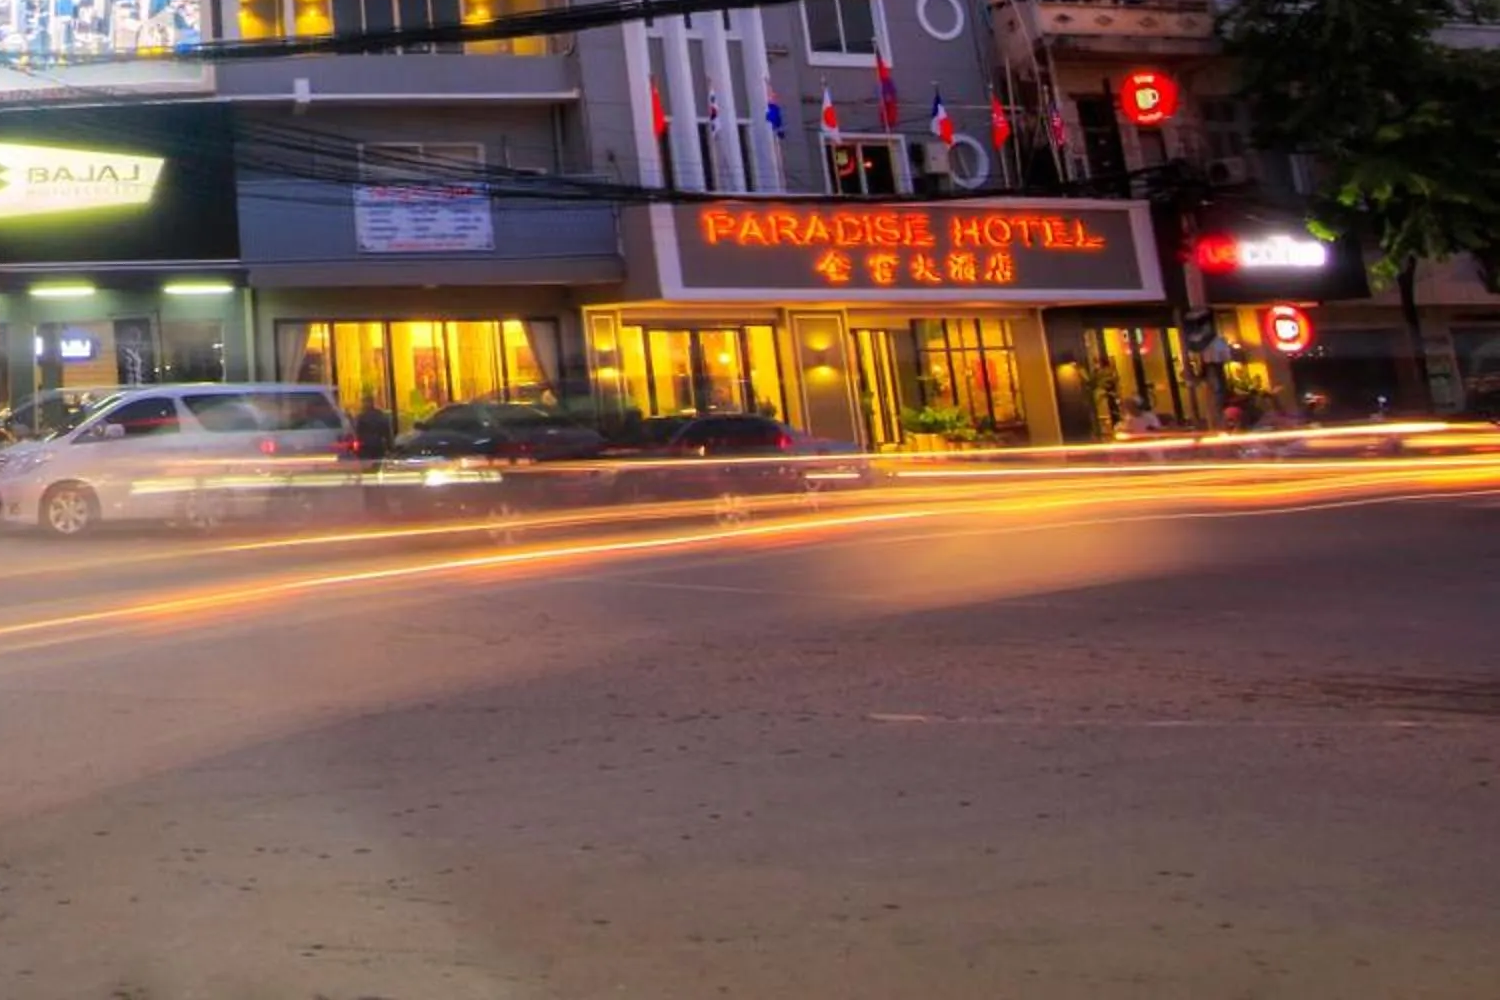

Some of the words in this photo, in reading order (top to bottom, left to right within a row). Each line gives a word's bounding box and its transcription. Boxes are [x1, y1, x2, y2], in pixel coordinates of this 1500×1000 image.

[27, 163, 140, 185] BAJAJ
[703, 208, 936, 247] PARADISE
[952, 213, 1107, 248] HOTEL
